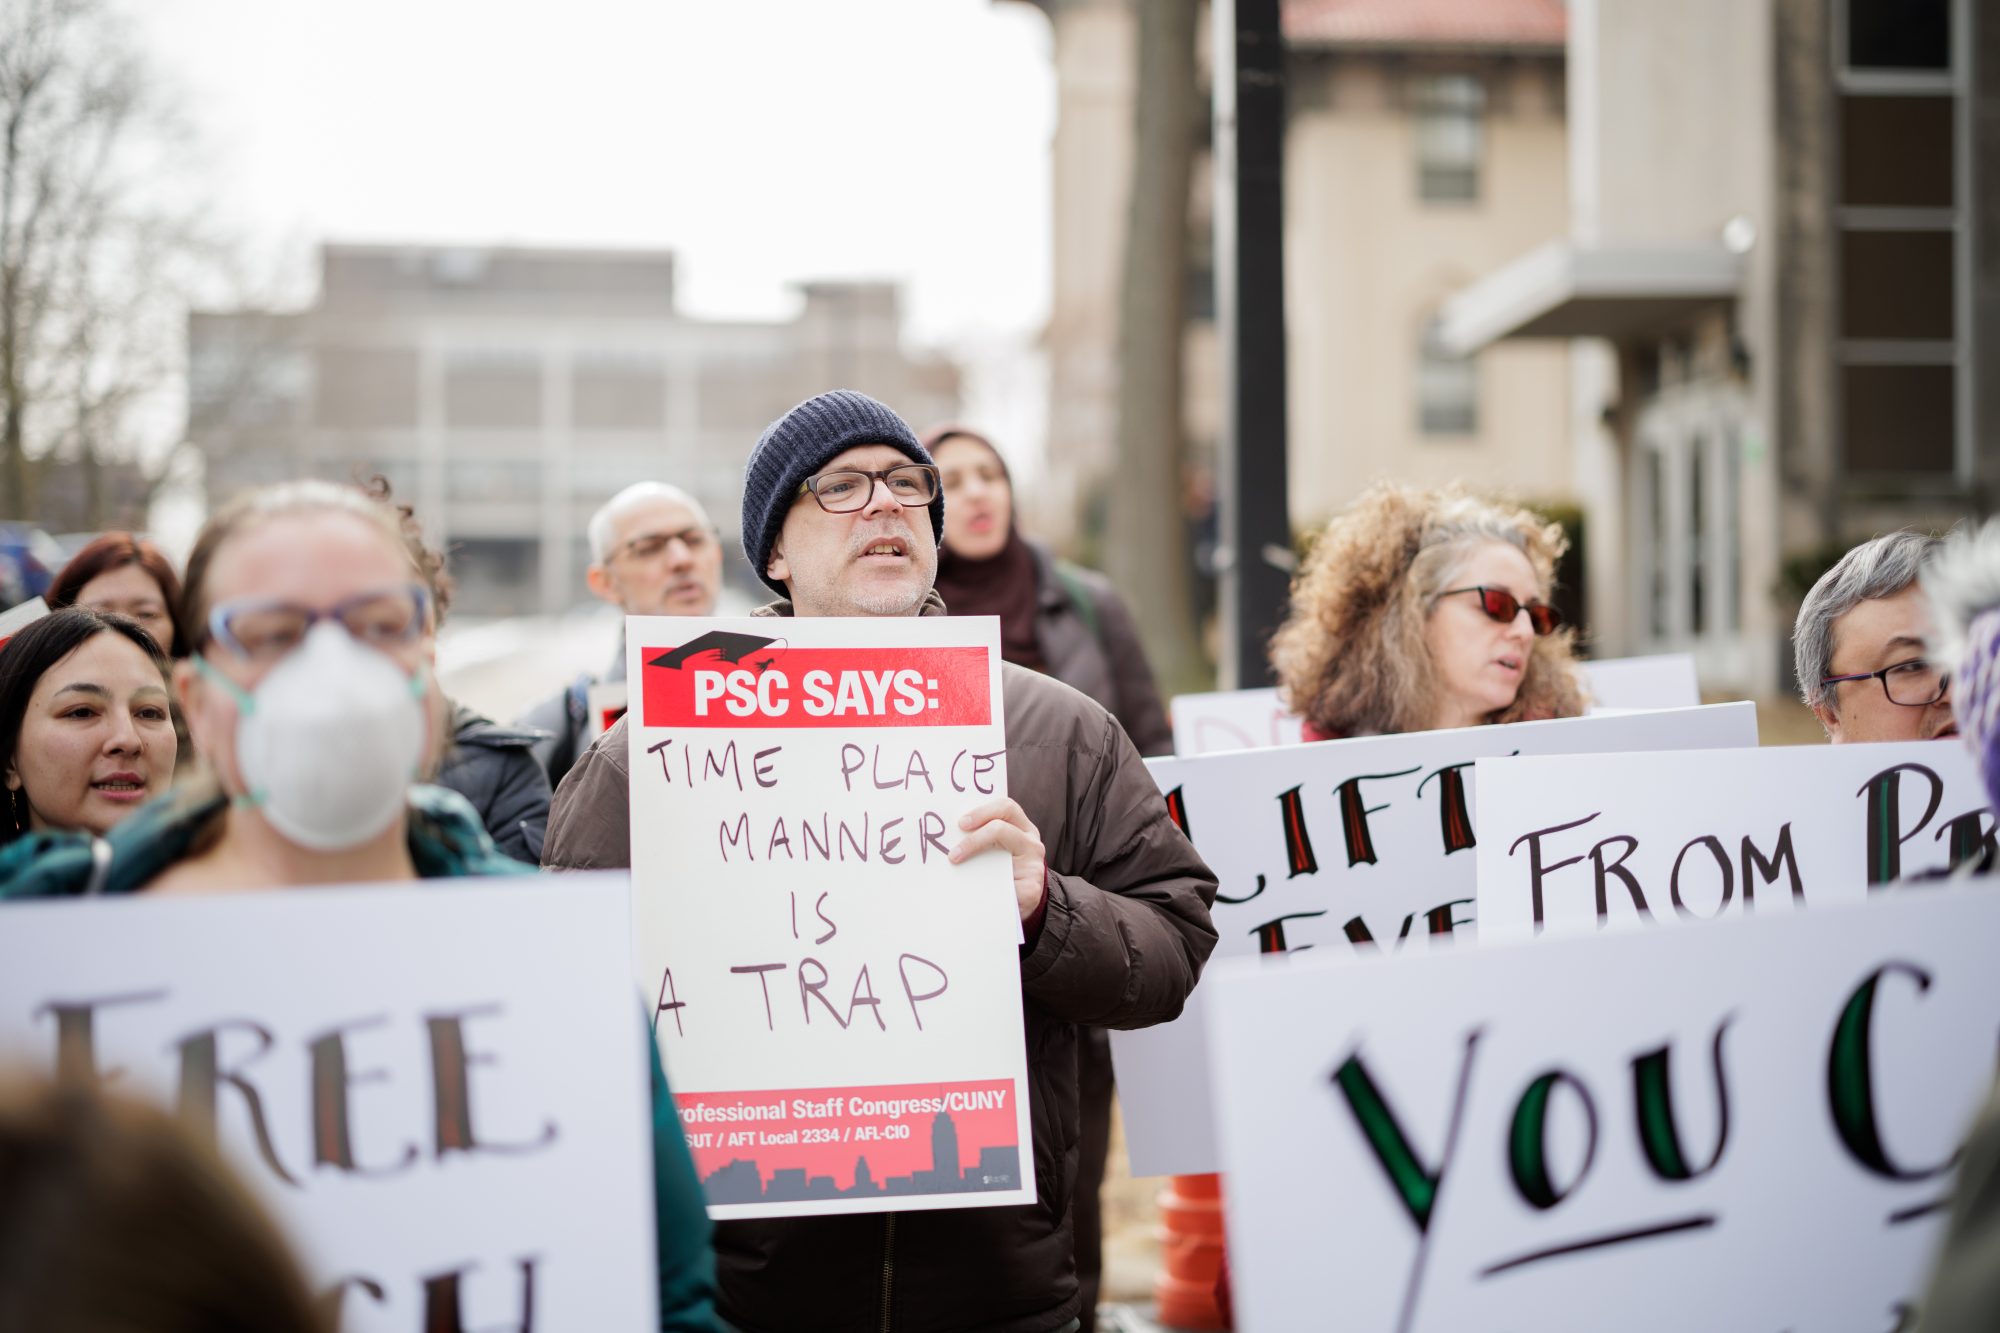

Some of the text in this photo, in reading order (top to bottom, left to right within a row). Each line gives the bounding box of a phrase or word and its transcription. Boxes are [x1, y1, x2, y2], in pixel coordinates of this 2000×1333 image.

[694, 669, 939, 717] PSC SAYS:
[647, 739, 1006, 794] TIME PLACE
[719, 811, 950, 864] MANNER
[1509, 811, 1807, 937] FROM
[791, 891, 836, 944] IS
[653, 952, 948, 1038] A TRAP
[792, 1098, 843, 1120] Staff
[848, 1090, 1007, 1119] Congress/CUNY
[716, 1133, 724, 1148] /
[728, 1131, 756, 1147] AFT
[760, 1130, 798, 1145] Local
[802, 1128, 840, 1143] 2334
[843, 1127, 851, 1143] /
[854, 1124, 911, 1141] AFL-CIO
[1330, 1006, 1737, 1333] YOU
